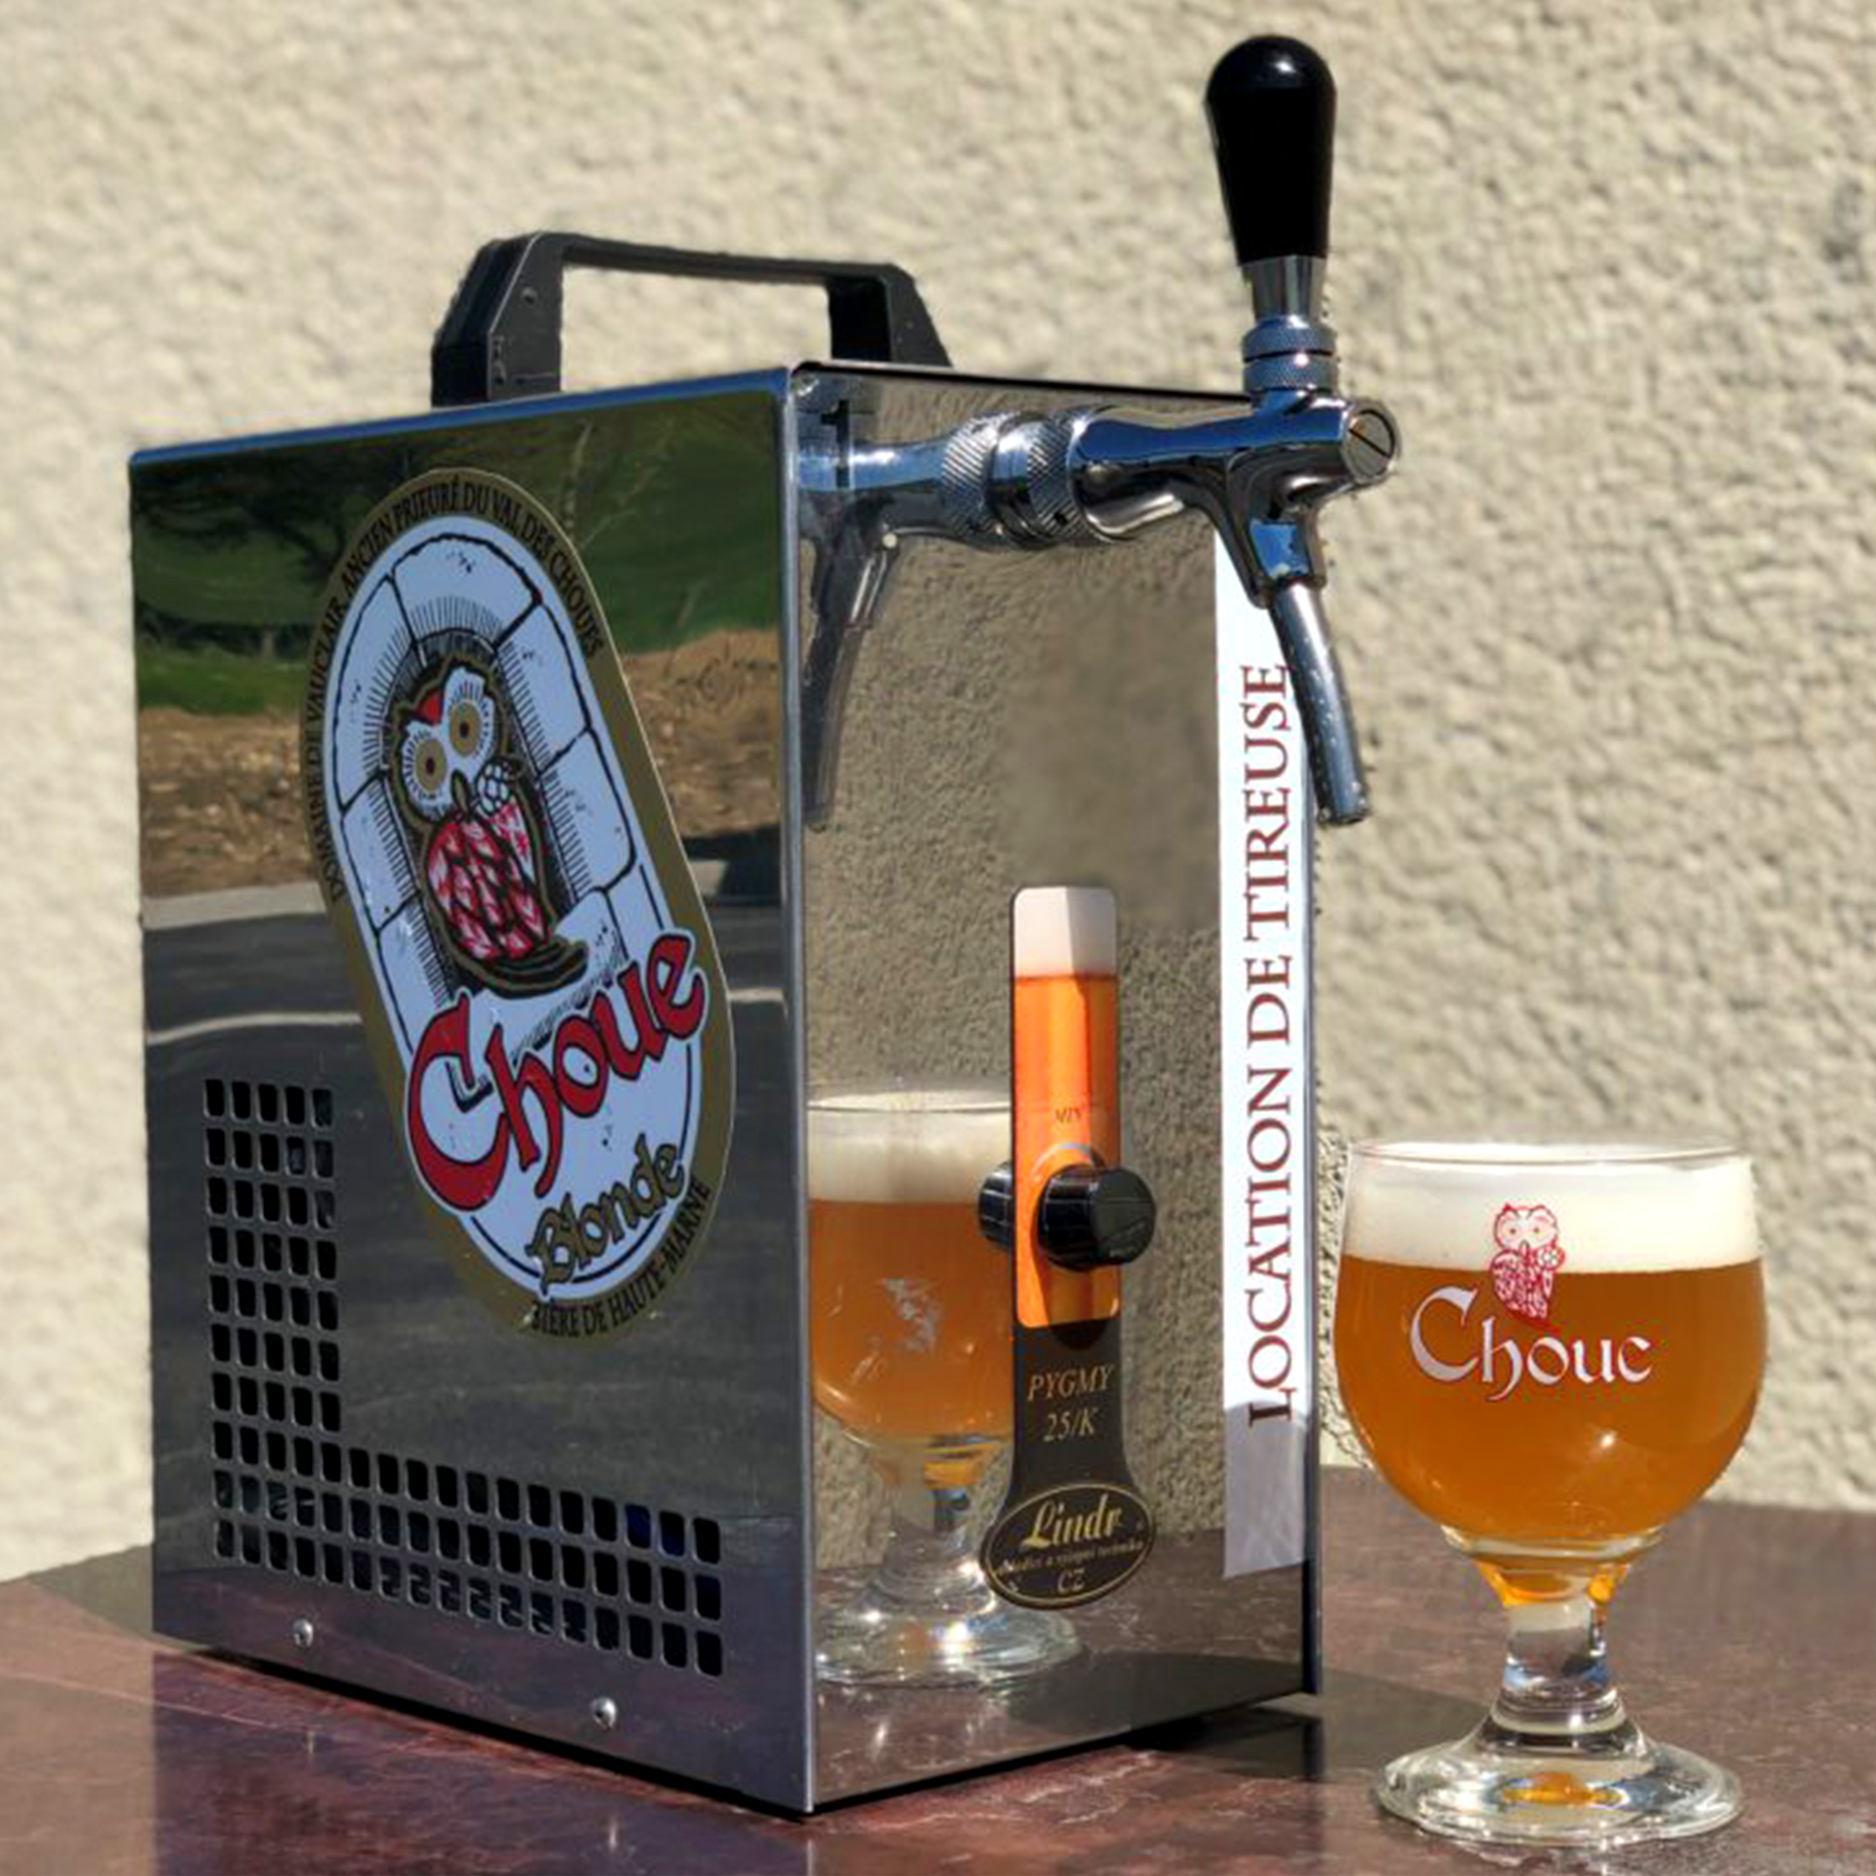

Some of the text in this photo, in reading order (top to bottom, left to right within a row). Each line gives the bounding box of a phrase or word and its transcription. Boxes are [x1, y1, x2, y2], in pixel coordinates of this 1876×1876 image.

[340, 513, 397, 600] ANCIEN
[392, 474, 460, 532] PRIEURÉ
[463, 482, 491, 514] DU
[491, 489, 524, 538] VAL
[519, 514, 557, 564] DES
[407, 934, 706, 1213] Choue
[1239, 664, 1297, 1427] LOCATION DE TIREUSE
[524, 1133, 686, 1297] Blonde
[531, 1175, 712, 1337] BIÈRE DE HAUTE-MARNE
[1027, 1365, 1113, 1400] PYGMY
[1044, 1408, 1096, 1441] 25/K
[1021, 1493, 1122, 1548] Lindr
